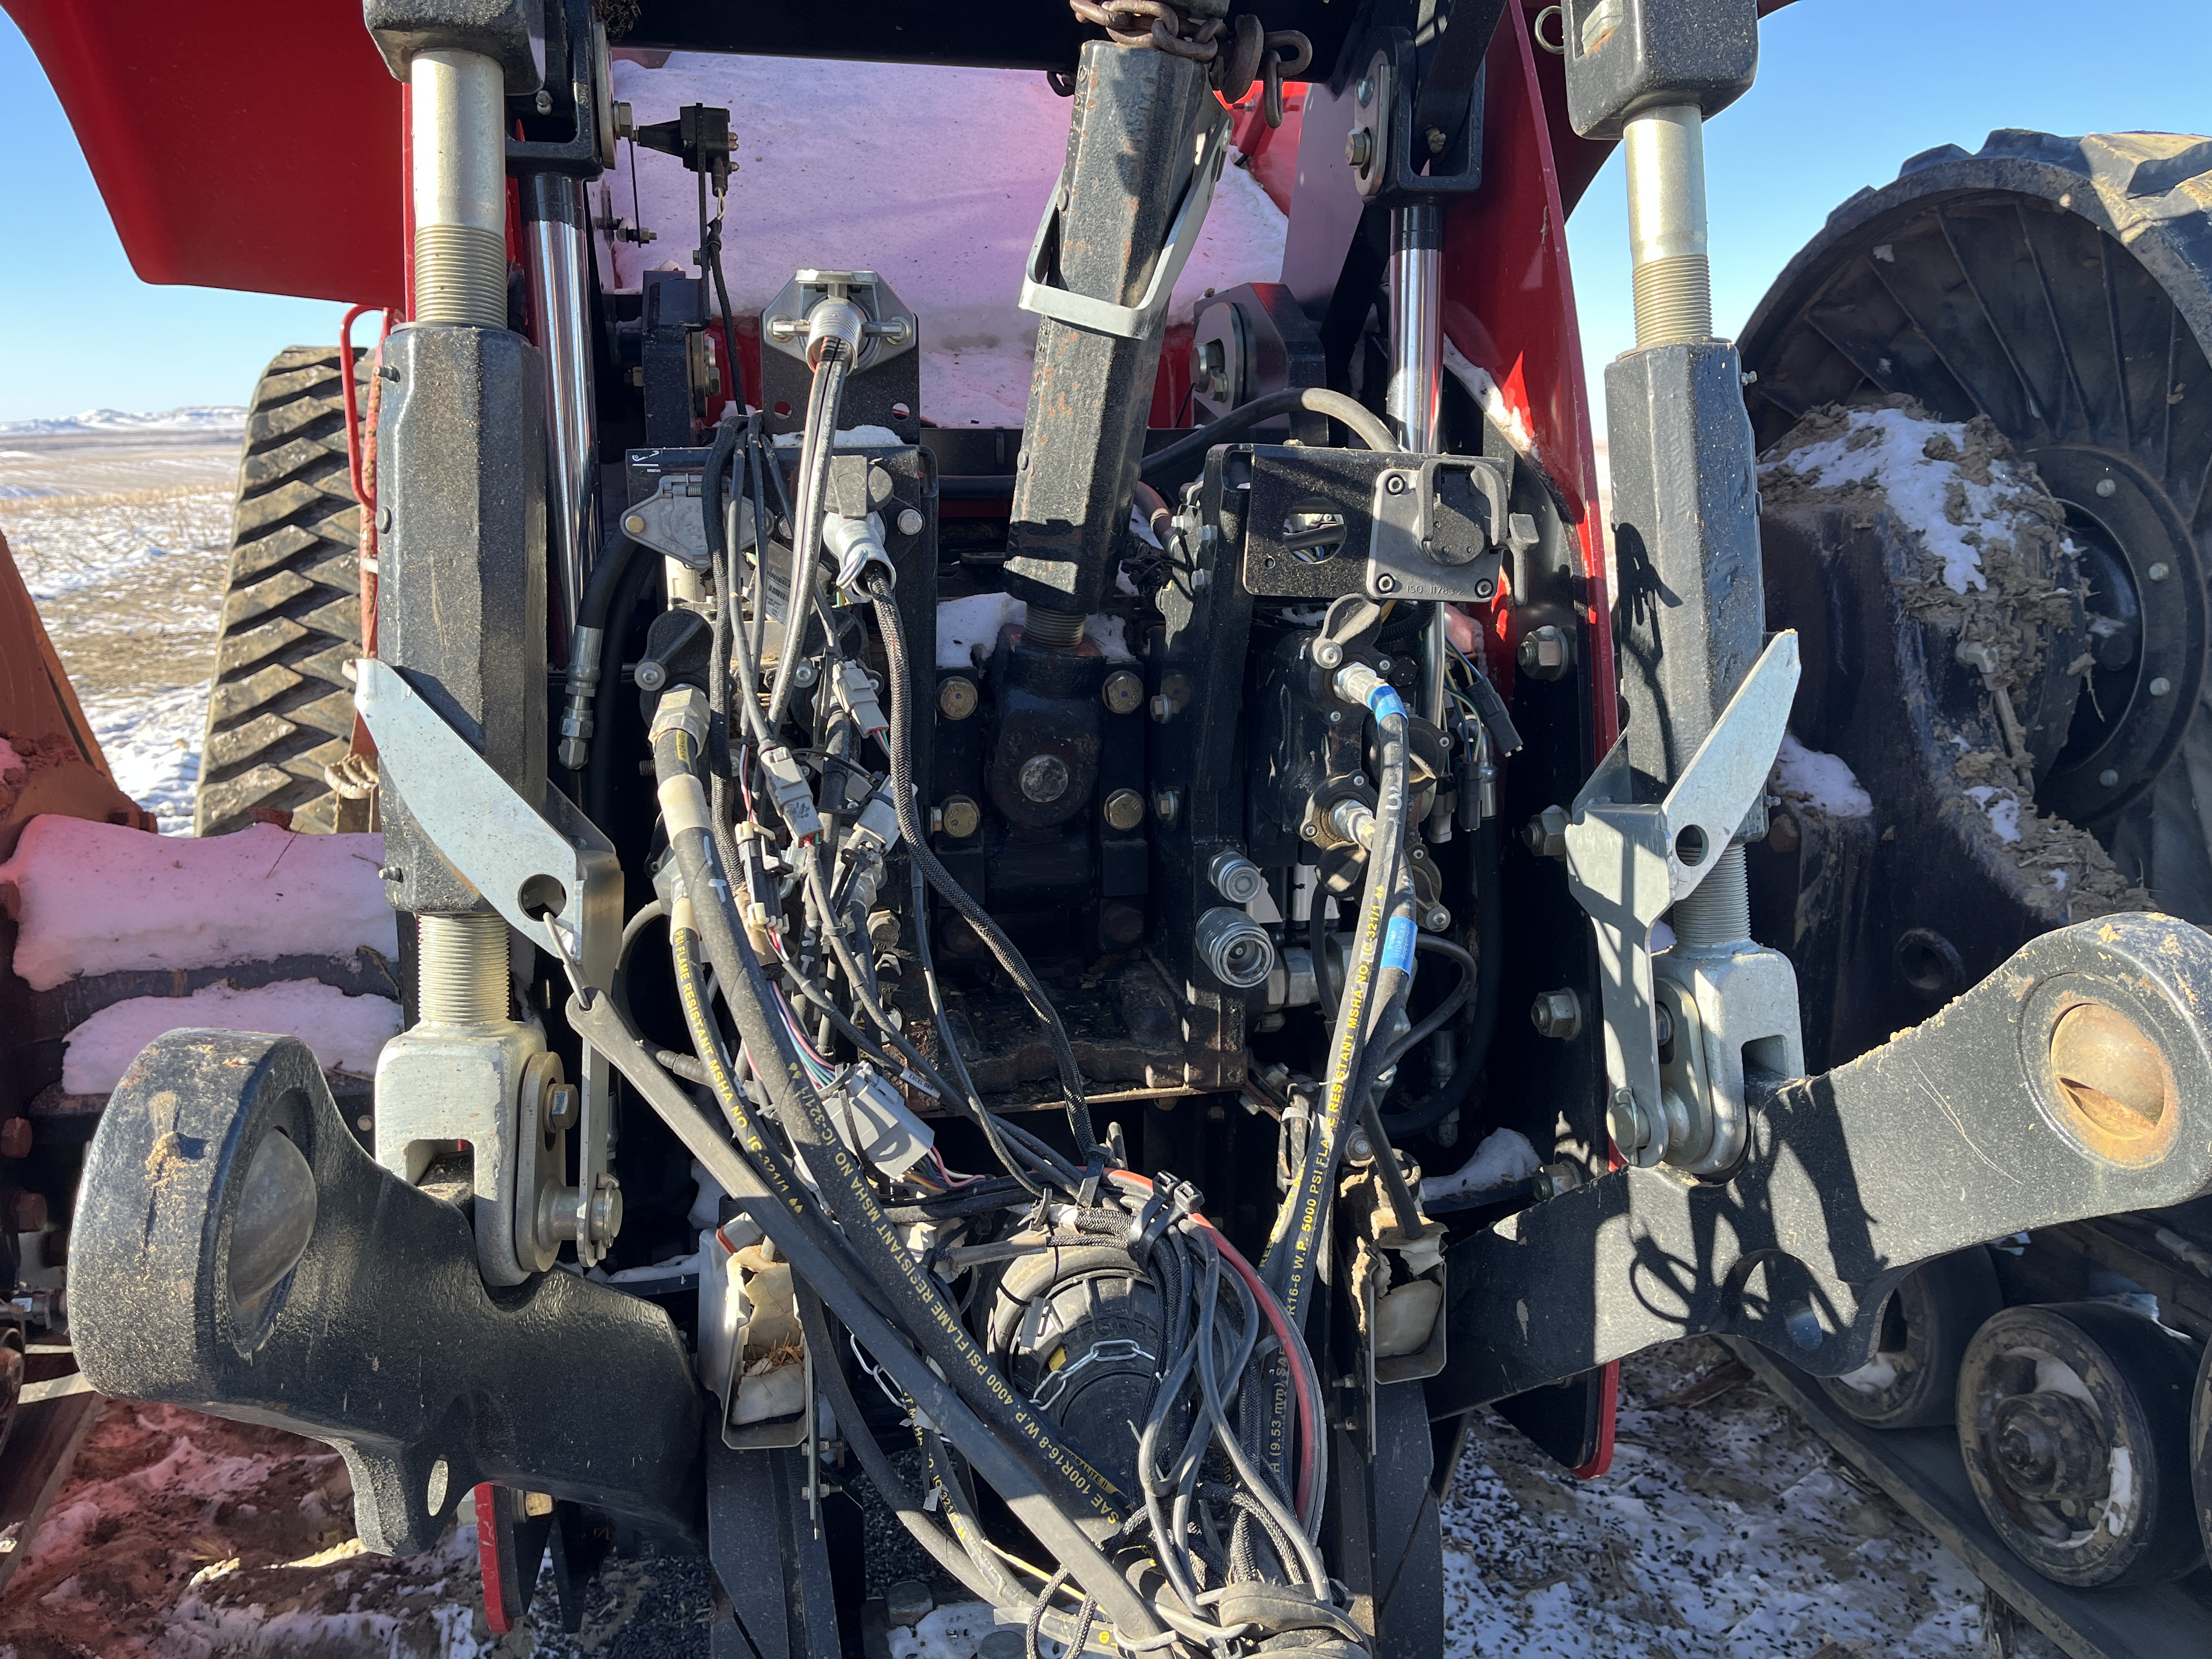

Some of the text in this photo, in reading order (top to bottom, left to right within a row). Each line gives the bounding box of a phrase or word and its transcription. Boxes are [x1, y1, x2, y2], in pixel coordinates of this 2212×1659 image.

[658, 538, 680, 552] COLE
[1407, 584, 1424, 594] ISO
[675, 930, 684, 946] PSI
[1363, 903, 1382, 957] IC-321/1
[1387, 929, 1397, 950] PUMP
[1393, 922, 1407, 958] HYDRAULIC
[676, 946, 690, 982] FLAME
[1356, 961, 1371, 985] NO.
[682, 982, 714, 1056] RESISTANT
[1346, 989, 1364, 1030] MSHA
[707, 1058, 733, 1104] MSHA
[909, 1073, 923, 1085] EXCEL
[1327, 1033, 1355, 1113] RESISTANT
[794, 1085, 837, 1146] IC-321/1
[1316, 1115, 1336, 1167] FLAE
[747, 1135, 789, 1193] IC-321/1
[834, 1146, 854, 1177] NO.
[850, 1176, 881, 1223] MSHA
[1309, 1169, 1324, 1195] PSI
[1301, 1198, 1317, 1232] 5000
[876, 1223, 935, 1304] RESISTANT
[1293, 1236, 1310, 1269] W.P.
[930, 1301, 969, 1352] FLAME
[966, 1349, 989, 1376] PSI
[986, 1374, 1014, 1406] 4000
[1273, 1382, 1286, 1415] mm)
[1269, 1419, 1282, 1457] (9.53
[1039, 1436, 1092, 1496] 100R16-8
[1091, 1493, 1120, 1525] SAE
